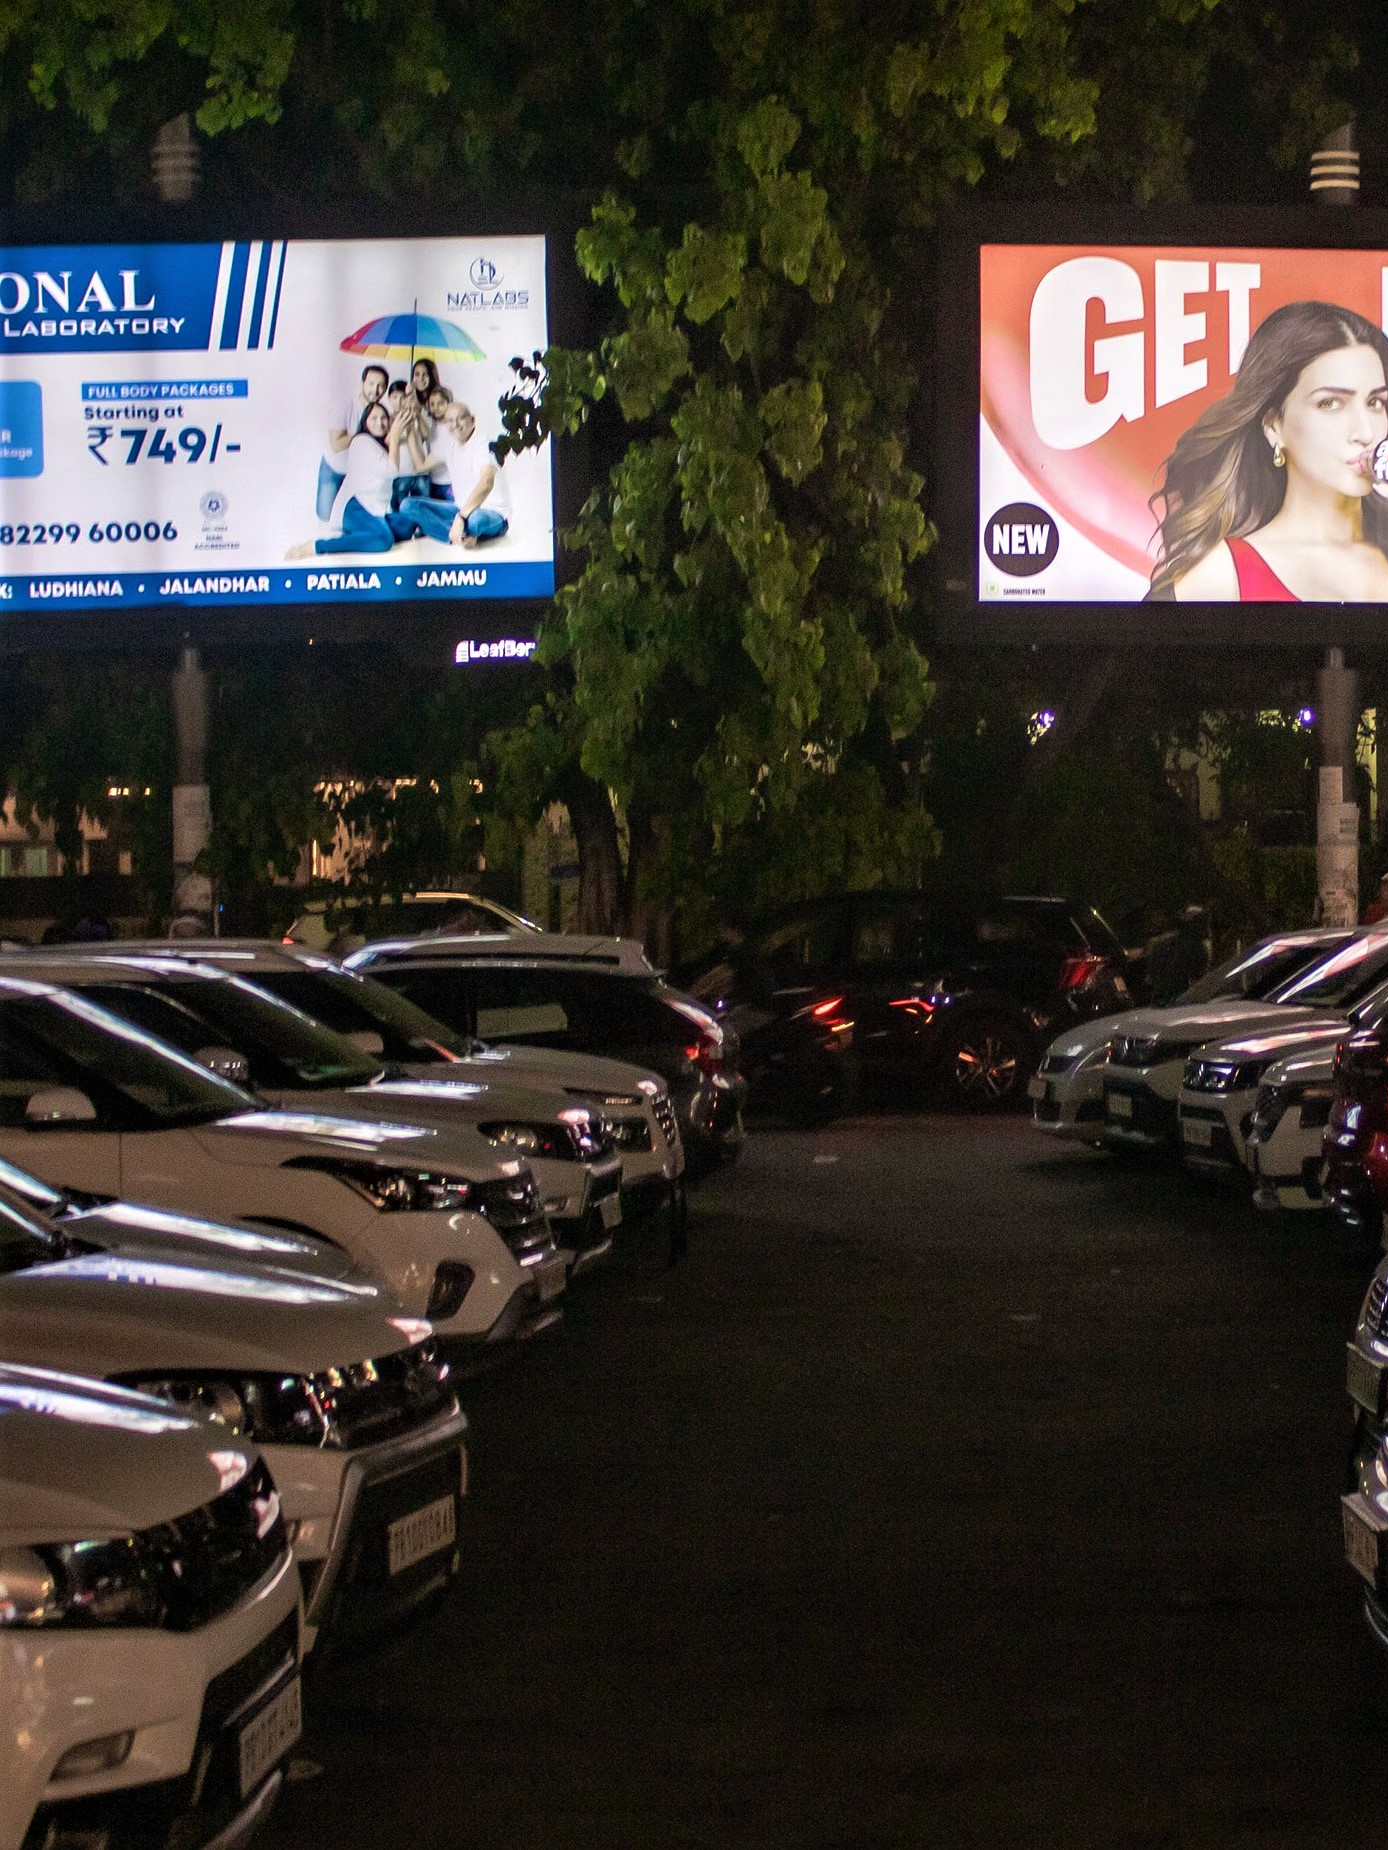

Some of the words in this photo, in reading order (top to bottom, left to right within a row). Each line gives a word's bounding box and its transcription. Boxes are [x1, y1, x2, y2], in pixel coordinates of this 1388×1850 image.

[0, 269, 156, 314] ONAL
[447, 290, 529, 306] NATLABS
[4, 317, 185, 337] LABORATORY
[1029, 255, 1261, 450] GET
[88, 385, 117, 398] FULL
[120, 385, 159, 398] BODY
[161, 383, 234, 397] PACKAGES
[84, 405, 159, 422] Starting
[163, 404, 184, 418] at
[0, 523, 81, 546] 82299
[88, 521, 178, 543] 60006
[992, 523, 1050, 555] NEW
[29, 579, 123, 598] LUDHIANA
[159, 575, 269, 595] JALANDHAR
[307, 572, 381, 591] PATIALA
[416, 569, 487, 588] JAMMU
